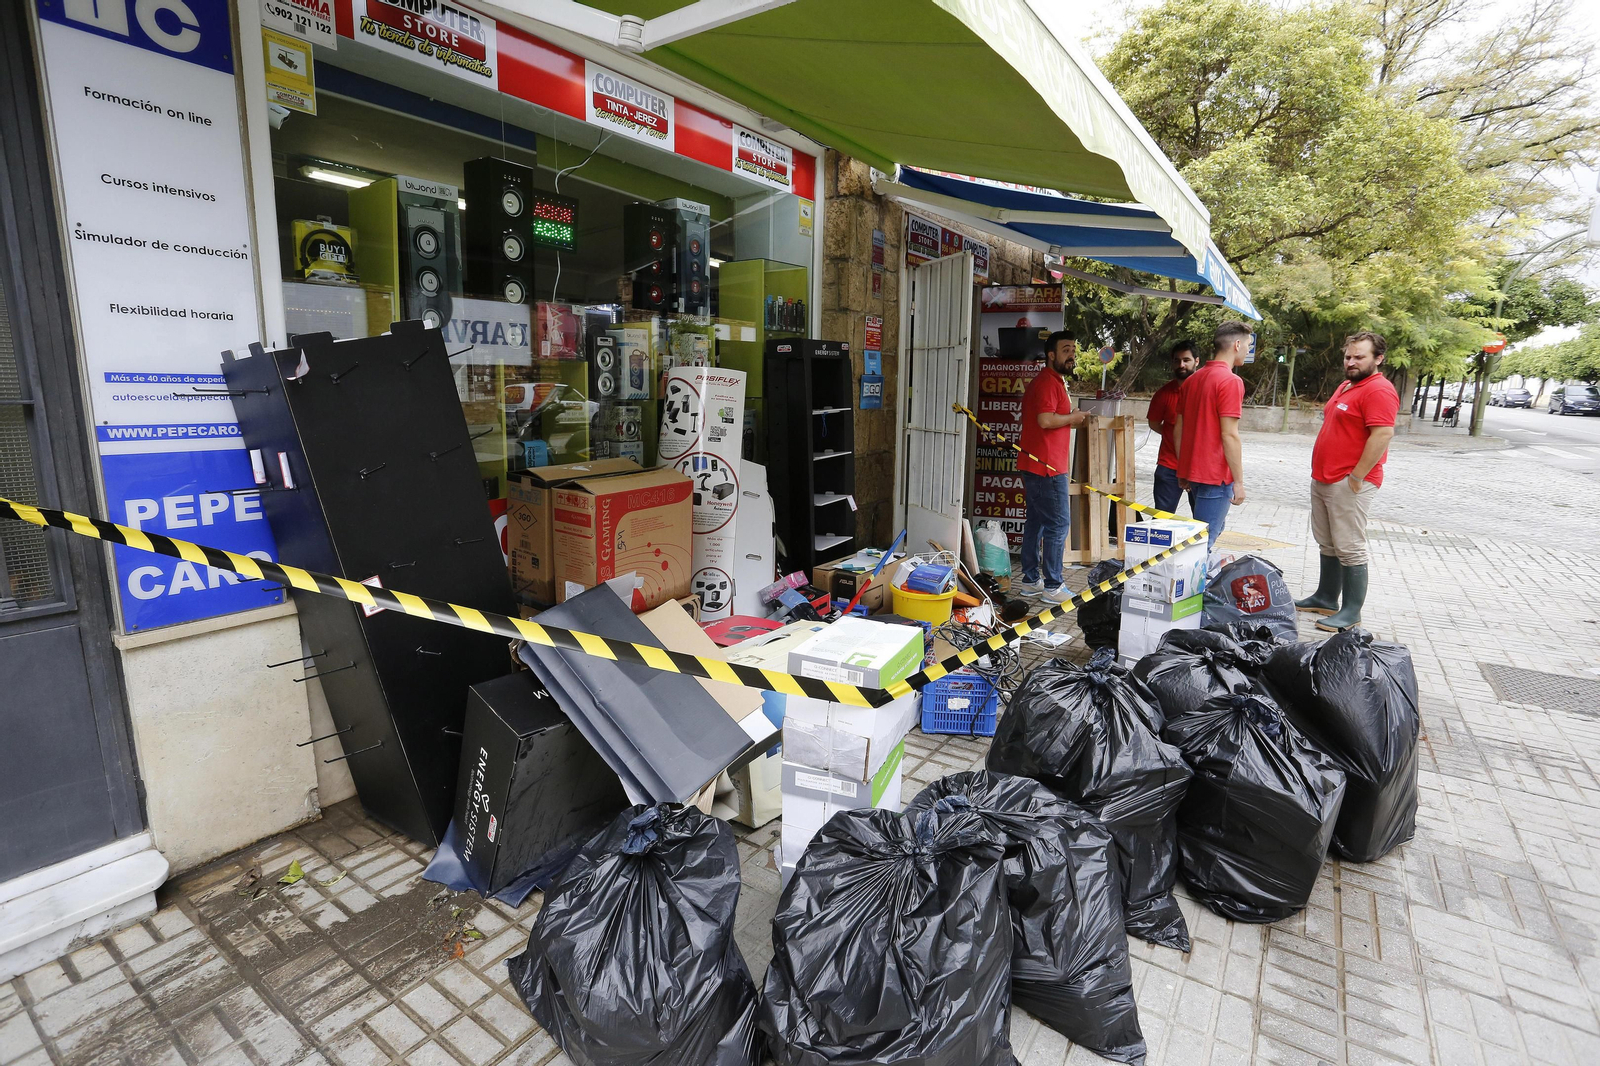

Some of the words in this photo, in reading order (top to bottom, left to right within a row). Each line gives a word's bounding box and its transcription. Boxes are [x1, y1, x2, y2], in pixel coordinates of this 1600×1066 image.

[275, 7, 292, 20] 902
[296, 14, 311, 27] 121
[316, 21, 331, 34] 122
[360, 16, 376, 35] Tu
[379, 24, 416, 48] tienda
[419, 39, 433, 55] de
[403, 15, 459, 47] STORE
[595, 73, 666, 119] COMPUTER
[84, 86, 162, 114] Formación
[167, 107, 186, 121] on
[188, 111, 212, 126] line
[606, 99, 629, 116] TINTA
[634, 111, 657, 127] JEREZ
[595, 108, 636, 130] Cartuchos
[646, 126, 668, 140] Toner
[740, 131, 786, 162] COMPUTER
[752, 153, 776, 169] STORE
[100, 173, 149, 191] Cursos
[152, 181, 216, 202] intensivos
[405, 180, 436, 194] biwond
[911, 220, 938, 238] COMPUTER
[74, 229, 147, 248] Simulador
[151, 238, 169, 251] de
[174, 242, 248, 260] conducción
[918, 236, 932, 246] STORE
[964, 240, 988, 259] COMPUTER
[1007, 288, 1062, 298] REPARA
[109, 303, 186, 319] Flexibilidad
[190, 309, 234, 321] horaria
[111, 374, 130, 382] Más
[864, 384, 880, 394] 3GO
[1010, 412, 1021, 421] Y
[977, 448, 1008, 457] FINANCIA
[975, 458, 988, 470] SIN
[990, 458, 1017, 472] INTE
[983, 476, 1024, 488] PAGA
[628, 487, 675, 509] MC416
[976, 492, 995, 502] EN
[998, 493, 1010, 505] 3,
[124, 490, 263, 531] PEPE
[518, 513, 531, 522] 3GO
[986, 507, 1000, 516] 12
[601, 498, 612, 561] GAMING
[472, 747, 488, 813] ENERGY
[463, 811, 478, 862] SISTEM
